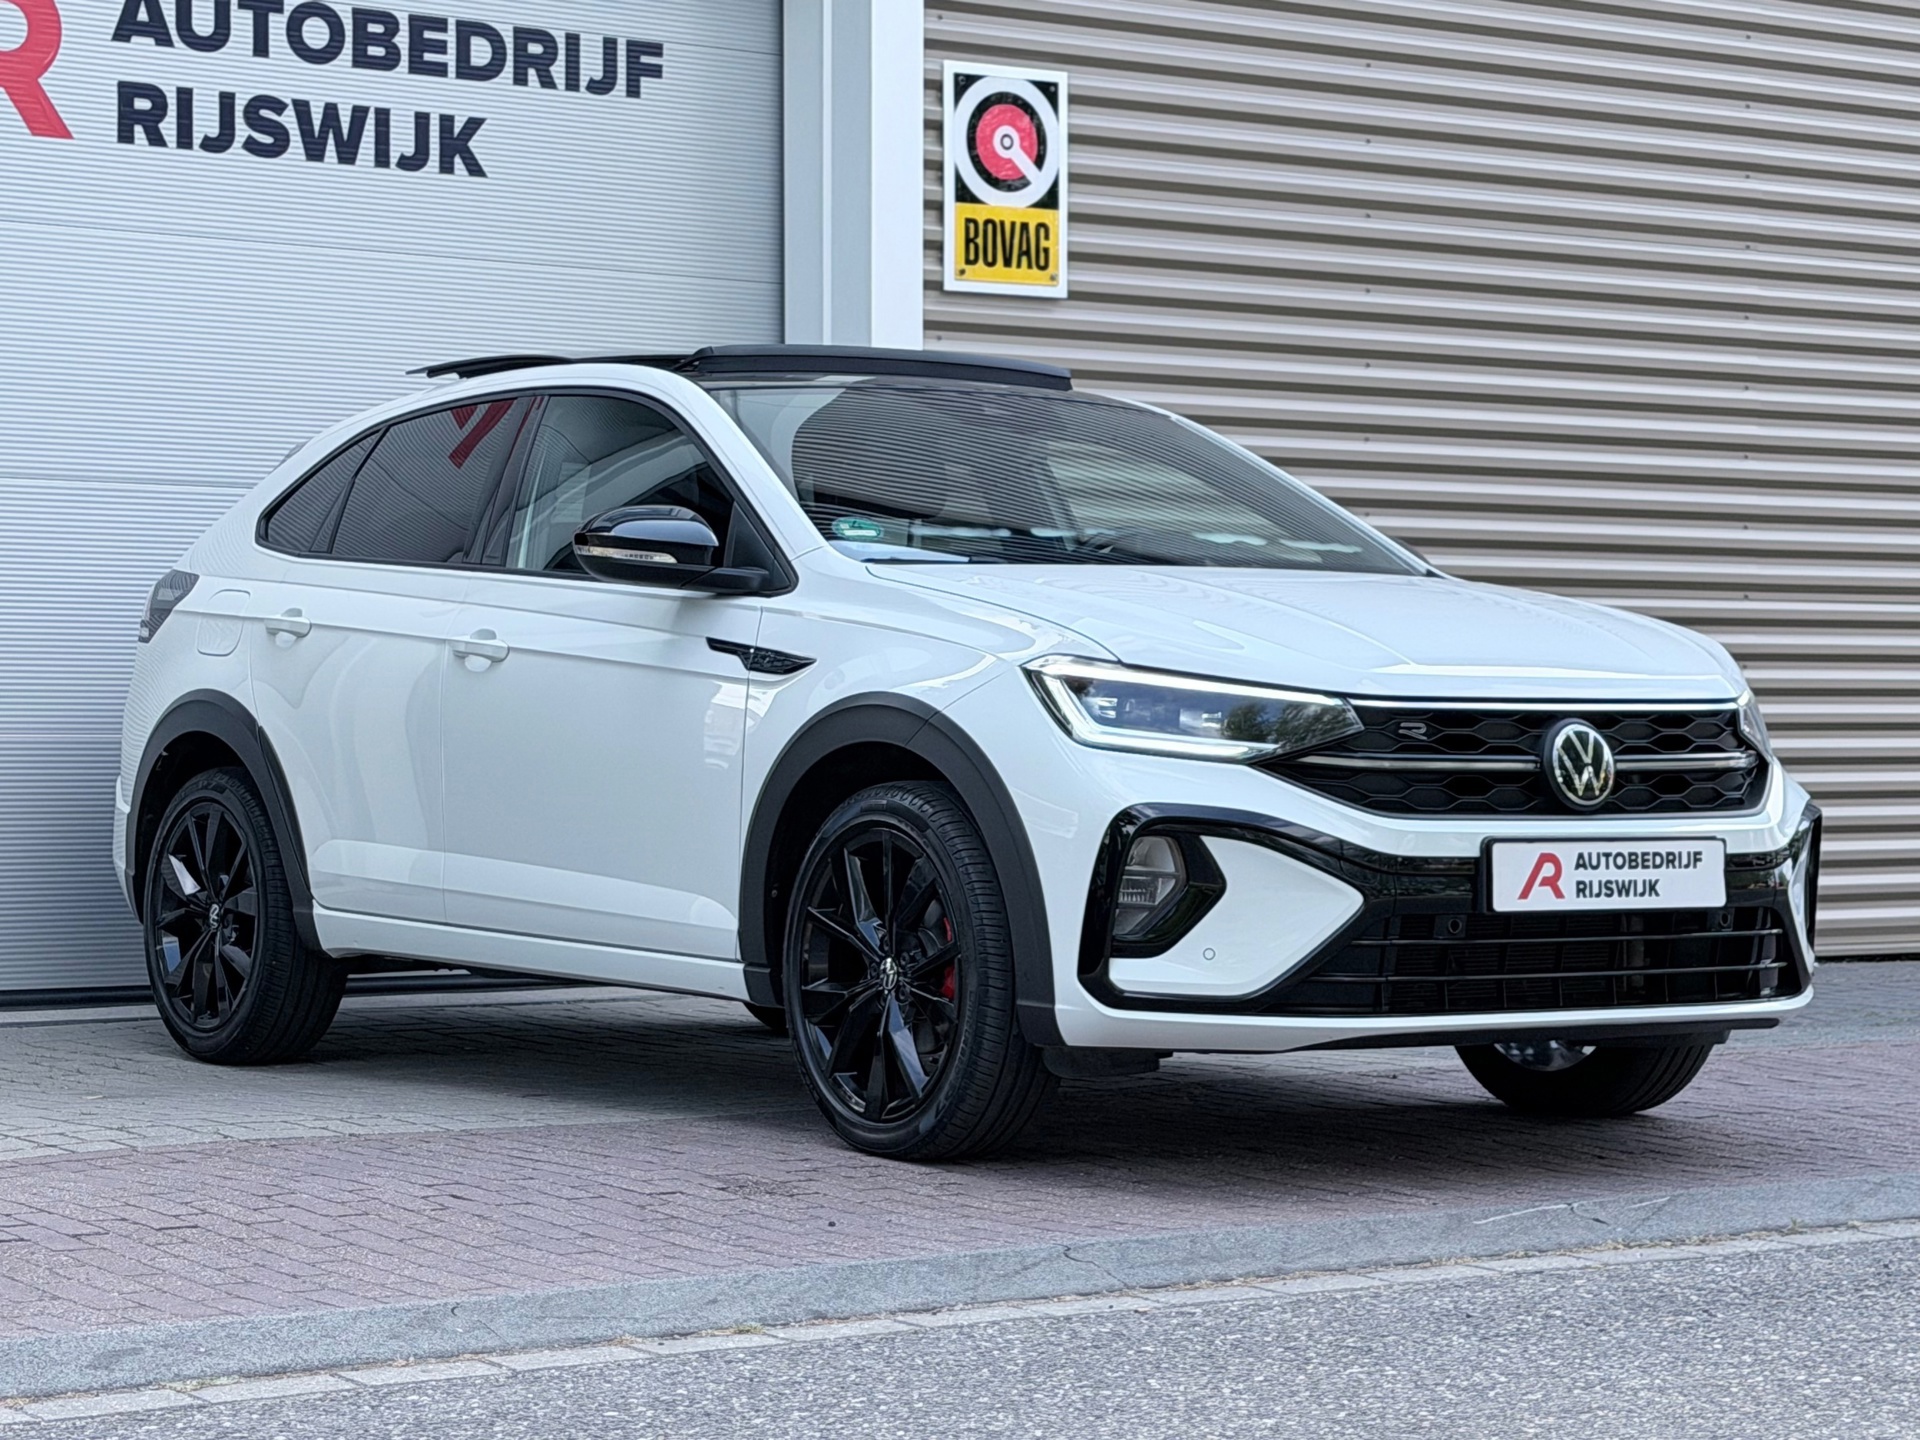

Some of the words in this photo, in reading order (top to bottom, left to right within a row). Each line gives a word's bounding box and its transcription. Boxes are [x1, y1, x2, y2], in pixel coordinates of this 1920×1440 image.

[111, 0, 664, 98] AUTOBEDRIJF
[116, 80, 488, 178] RIJSWIJK
[964, 217, 1050, 271] BOVAG
[1574, 851, 1703, 870] AUTOBEDRIJF
[1575, 878, 1660, 898] RIJSWIJK
